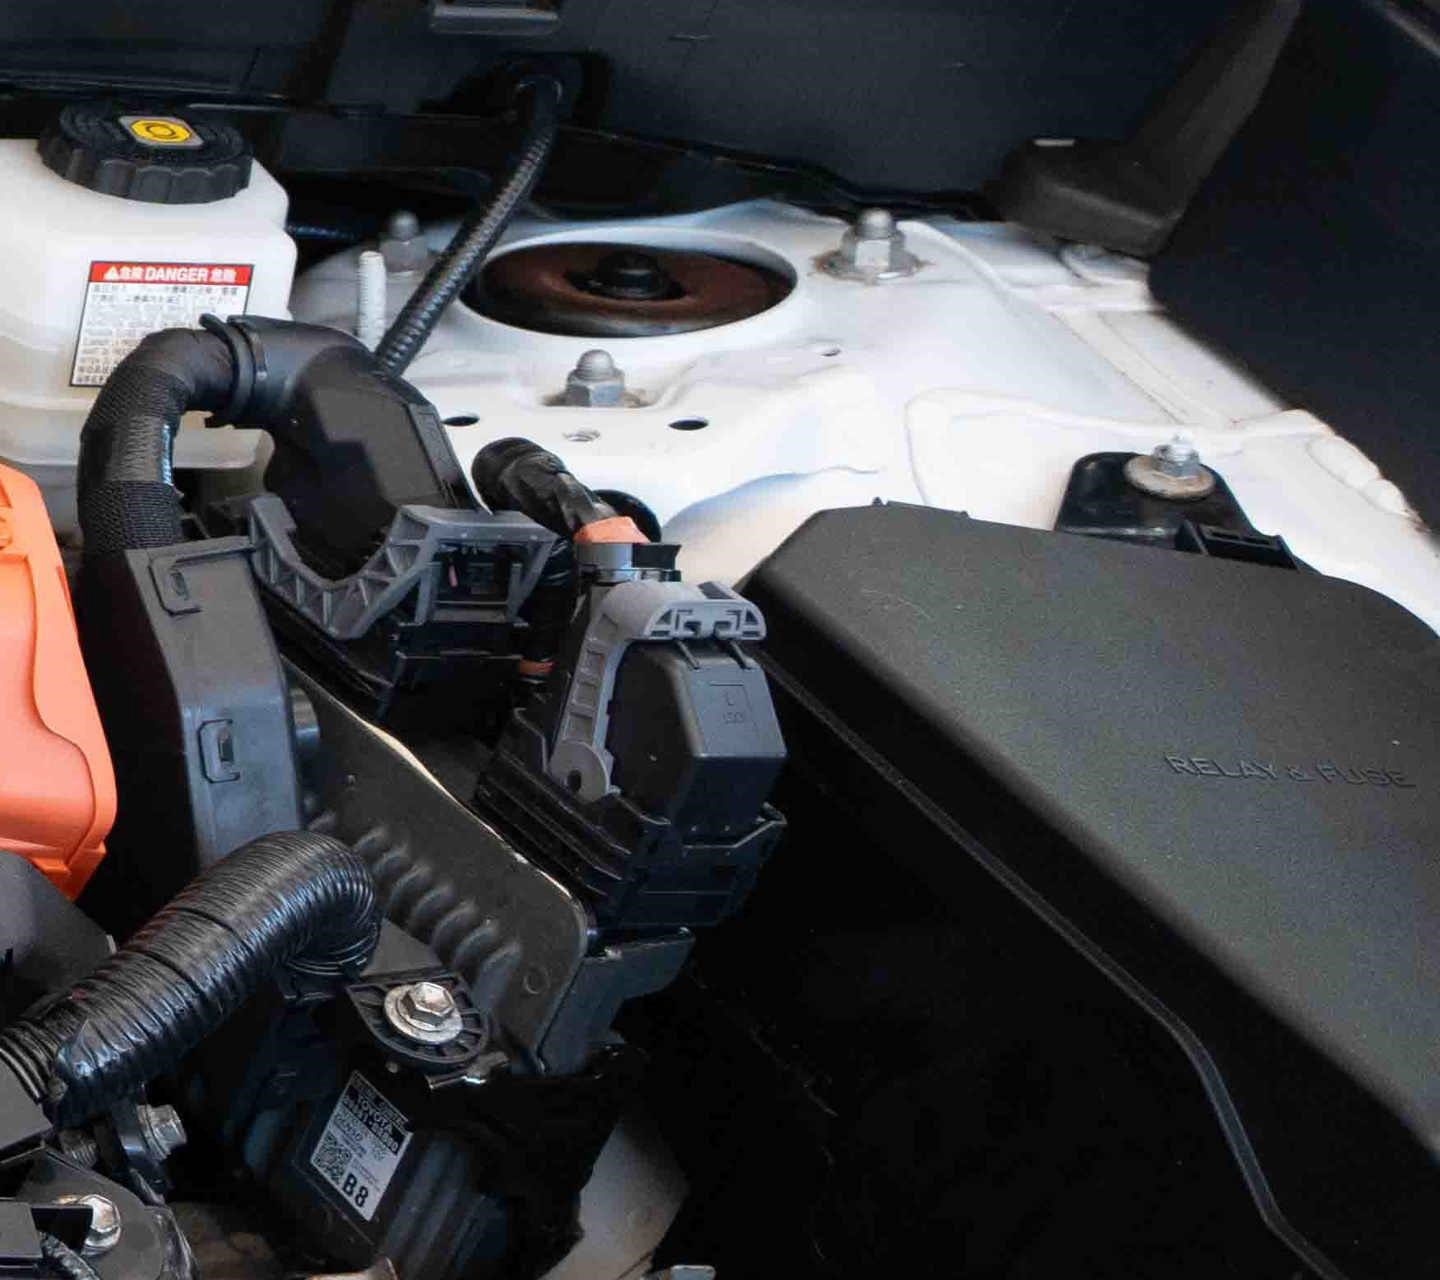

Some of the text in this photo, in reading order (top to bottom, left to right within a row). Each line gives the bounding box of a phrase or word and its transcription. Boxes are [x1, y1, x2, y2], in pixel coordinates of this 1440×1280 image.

[145, 267, 209, 282] DANGER
[1164, 754, 1278, 781] RELAY
[1316, 761, 1417, 788] FUSE
[357, 1095, 395, 1134] TOYOTA
[343, 1173, 369, 1208] B8
